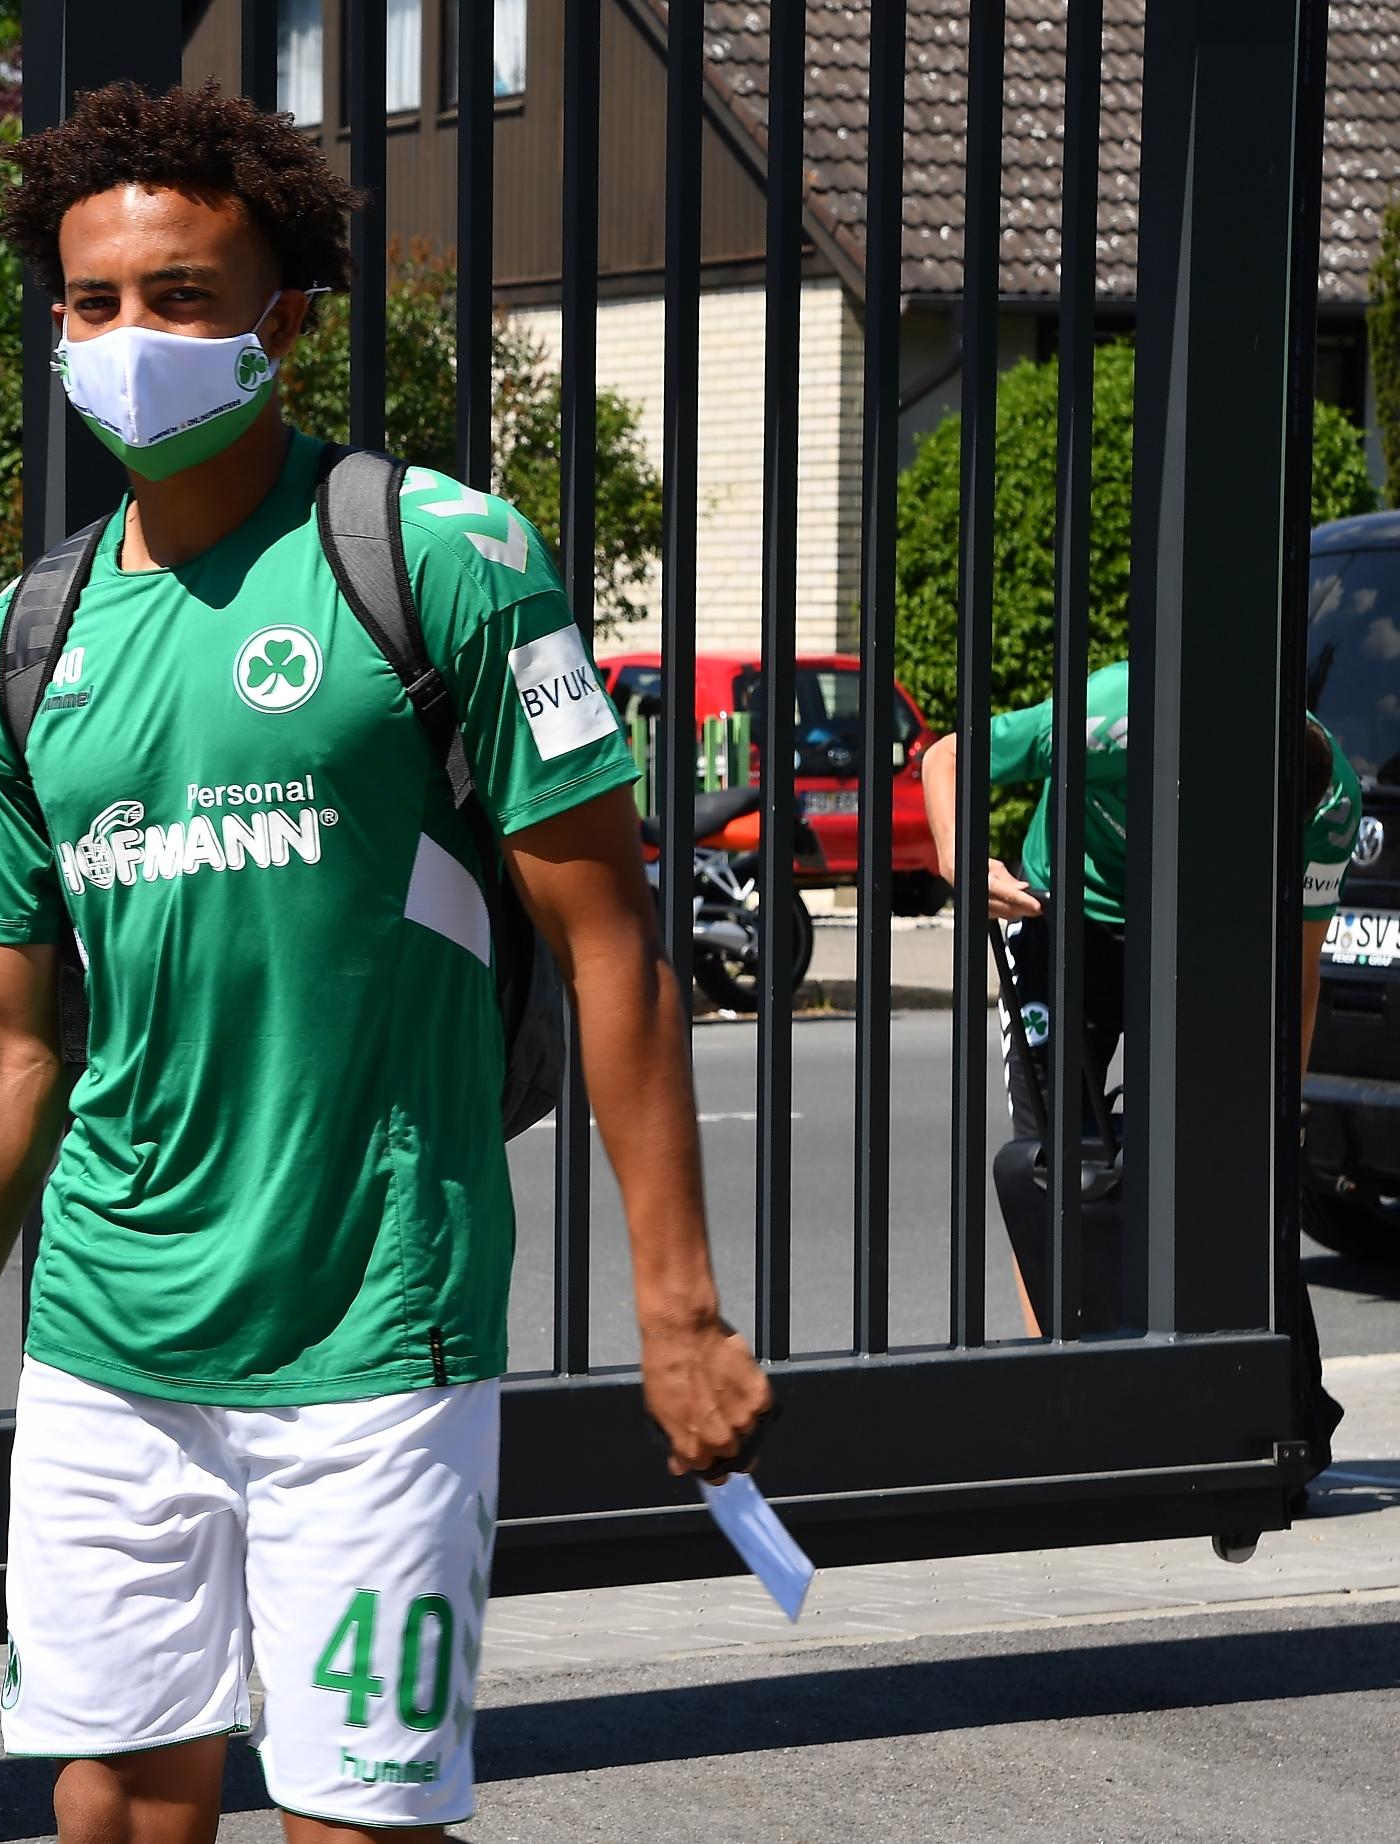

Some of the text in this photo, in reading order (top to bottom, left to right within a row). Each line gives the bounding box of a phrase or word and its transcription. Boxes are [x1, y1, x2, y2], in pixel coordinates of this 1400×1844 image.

[521, 666, 596, 719] BVUK
[186, 774, 315, 811] Personal
[311, 1587, 454, 1732] 40
[340, 1746, 442, 1784] hummel
